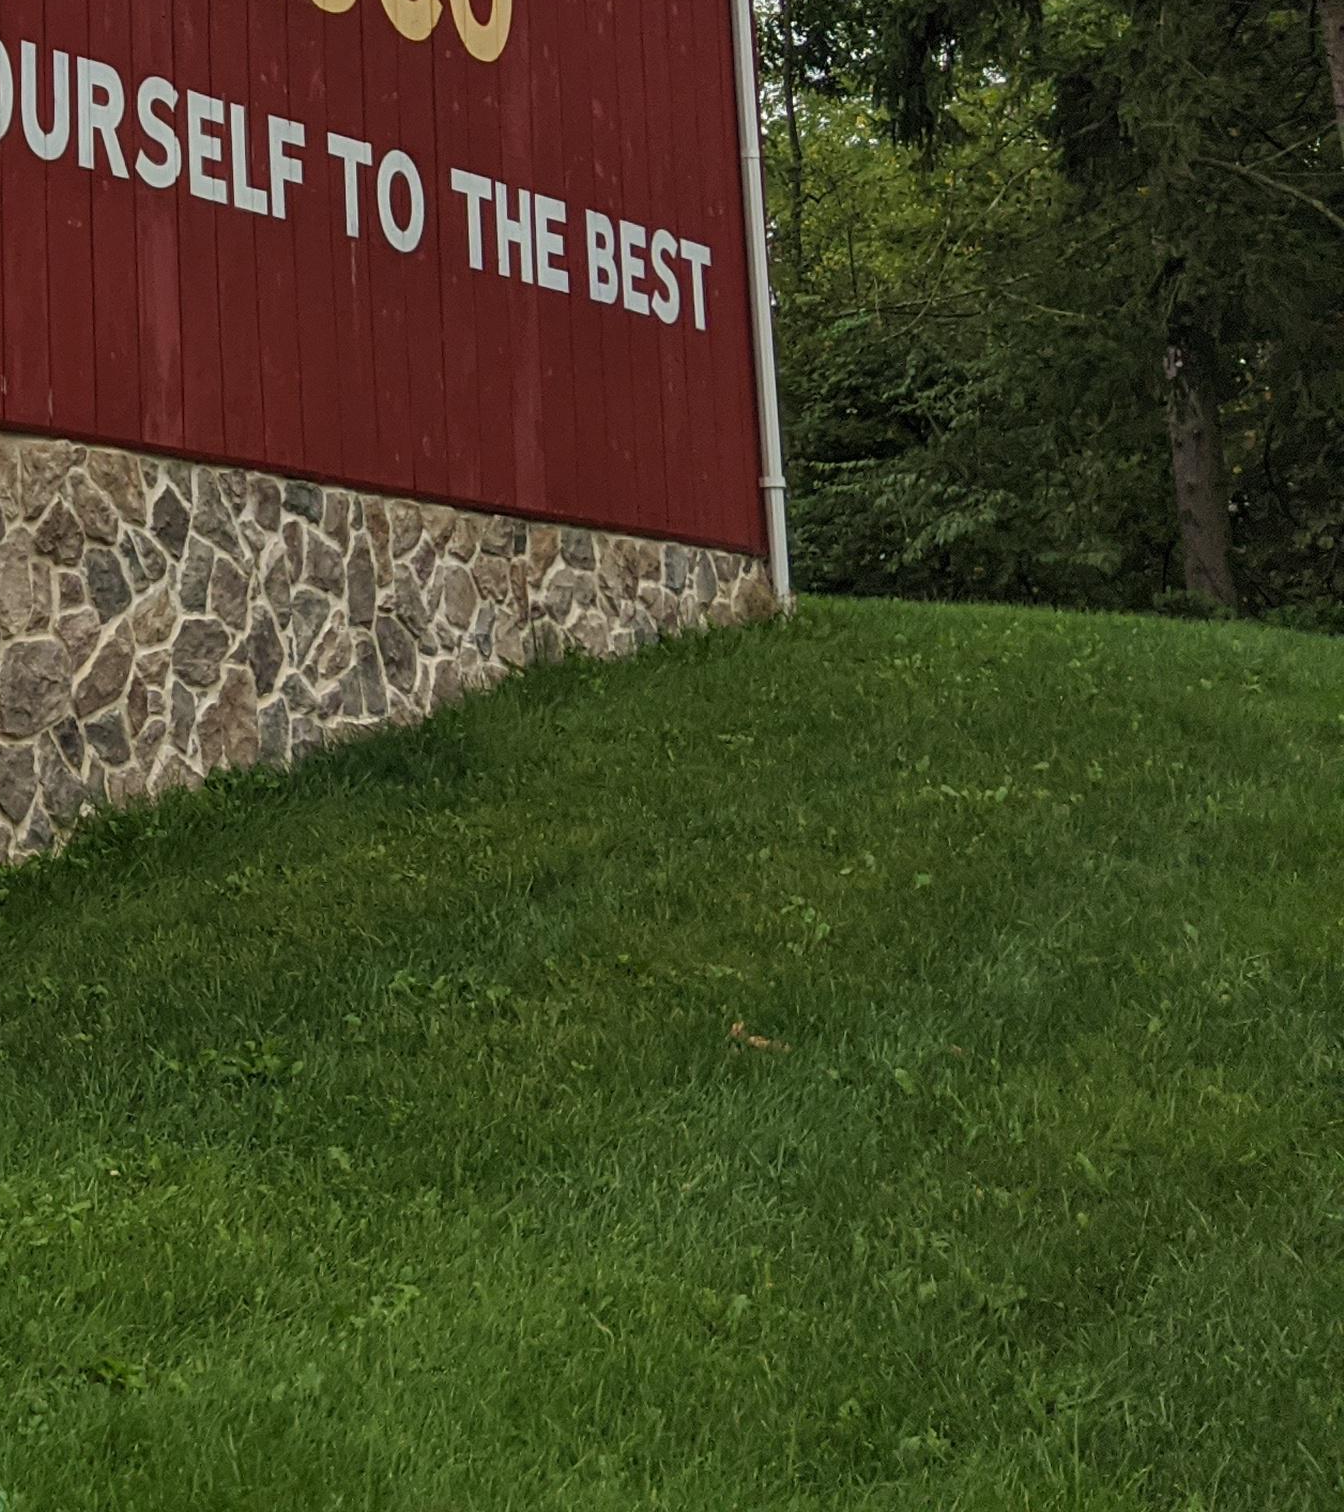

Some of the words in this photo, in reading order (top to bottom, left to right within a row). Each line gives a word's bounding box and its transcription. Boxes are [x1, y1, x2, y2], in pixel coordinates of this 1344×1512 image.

[326, 131, 425, 253] TO
[450, 168, 570, 294] THE
[585, 208, 712, 331] BEST
